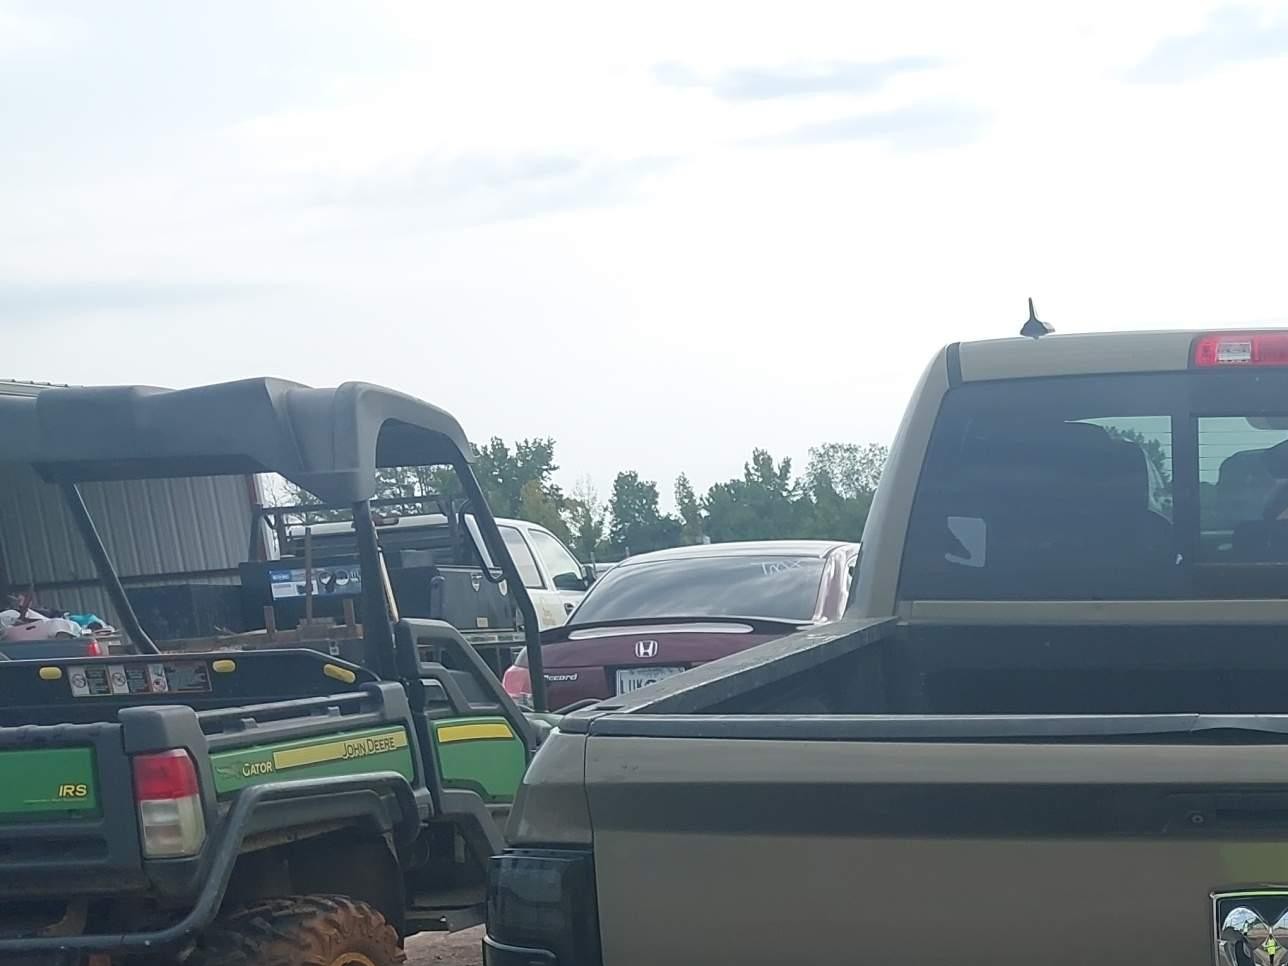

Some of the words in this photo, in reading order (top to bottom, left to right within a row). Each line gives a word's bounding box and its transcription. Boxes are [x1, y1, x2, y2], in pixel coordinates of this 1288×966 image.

[343, 742, 367, 758] JOHN
[367, 737, 395, 752] DEERE
[242, 761, 272, 777] GATOR
[58, 784, 87, 797] IRS
